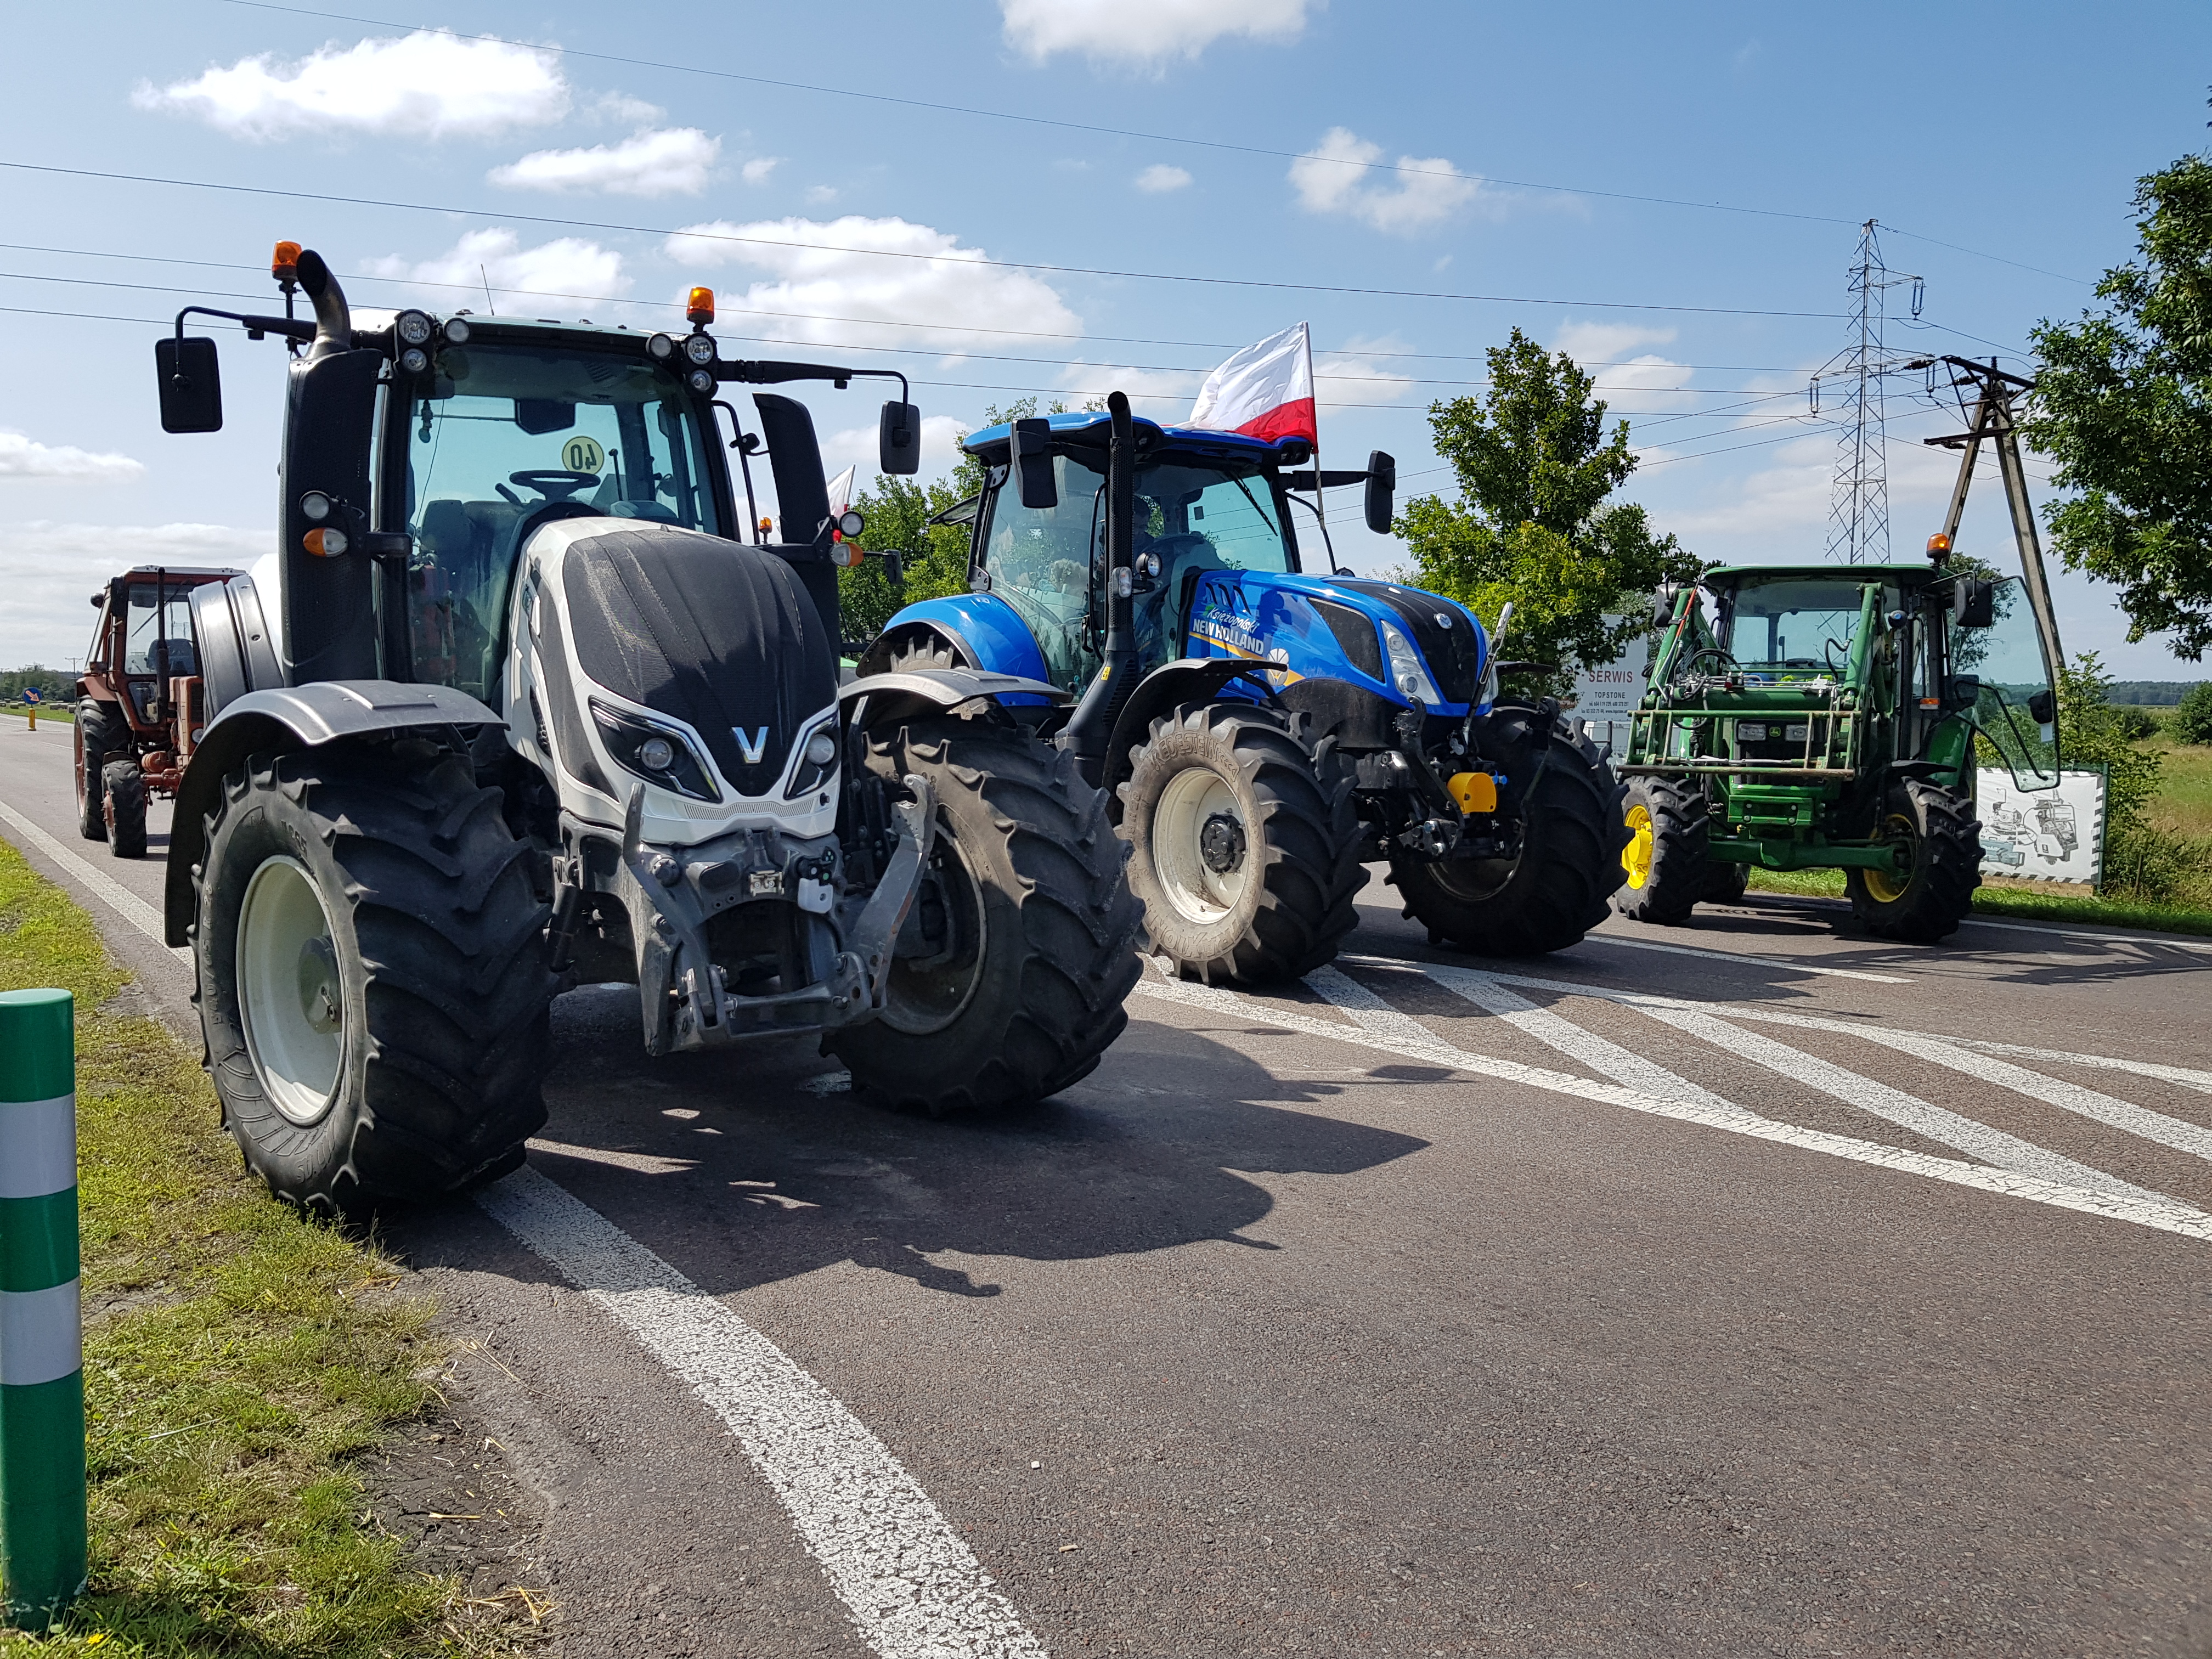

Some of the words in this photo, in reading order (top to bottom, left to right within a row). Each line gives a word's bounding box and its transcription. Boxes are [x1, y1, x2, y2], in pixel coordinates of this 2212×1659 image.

[1207, 607, 1260, 634] Księżopolski
[1193, 618, 1215, 636] NEW
[1215, 624, 1264, 655] HOLLAND
[1588, 670, 1633, 683] SERWIS
